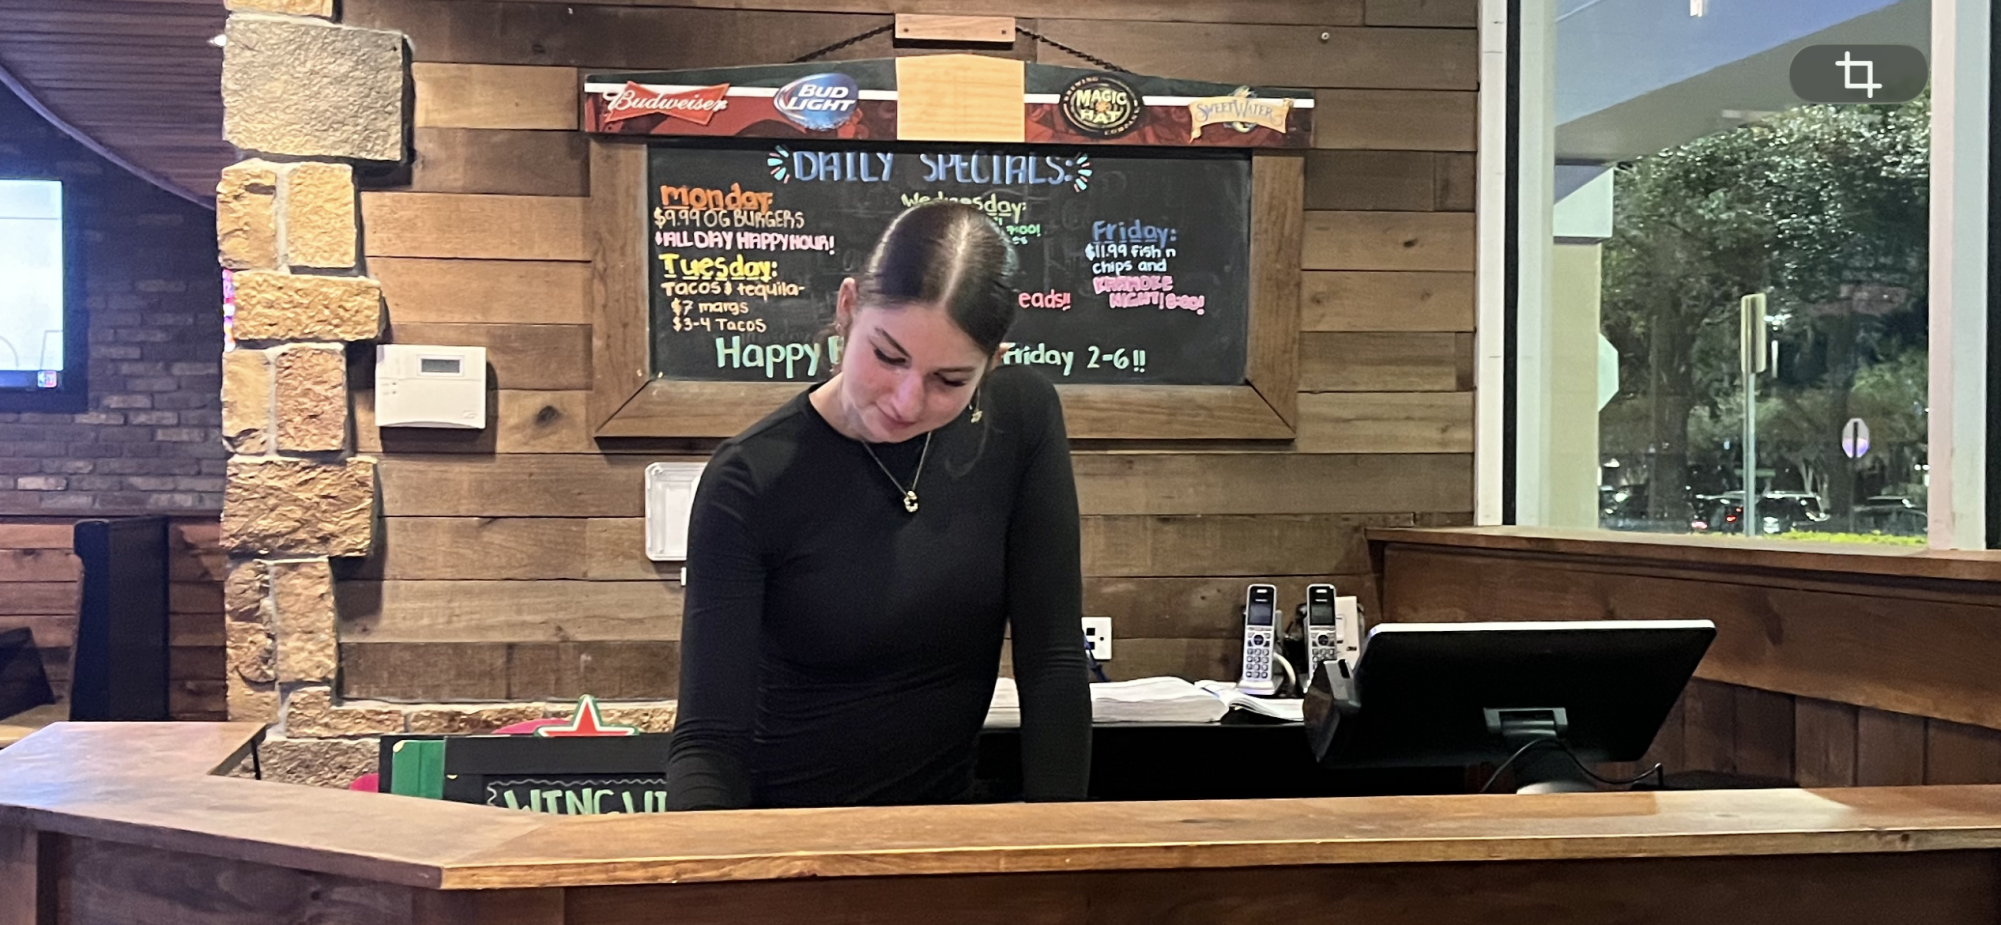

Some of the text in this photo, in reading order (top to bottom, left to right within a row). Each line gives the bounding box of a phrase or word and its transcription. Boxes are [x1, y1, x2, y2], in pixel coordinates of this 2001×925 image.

[602, 89, 728, 112] Budweiser
[798, 84, 849, 99] BUD
[1076, 89, 1127, 107] MAGIC
[786, 97, 856, 112] LIGHT
[1080, 109, 1122, 124] HAT
[792, 151, 1074, 185] DAILY SPECIALS:
[653, 207, 805, 229] $9.99 OG BURGERS
[663, 231, 694, 248] ALL
[694, 231, 733, 249] DAY
[736, 232, 789, 252] HAPPY
[1092, 219, 1178, 249] Friday:
[1130, 245, 1161, 259] fish
[1165, 248, 1177, 258] n
[658, 253, 778, 282] Tuesday:
[1092, 258, 1167, 276] chips and
[698, 301, 750, 317] margs
[715, 335, 820, 379] Happy
